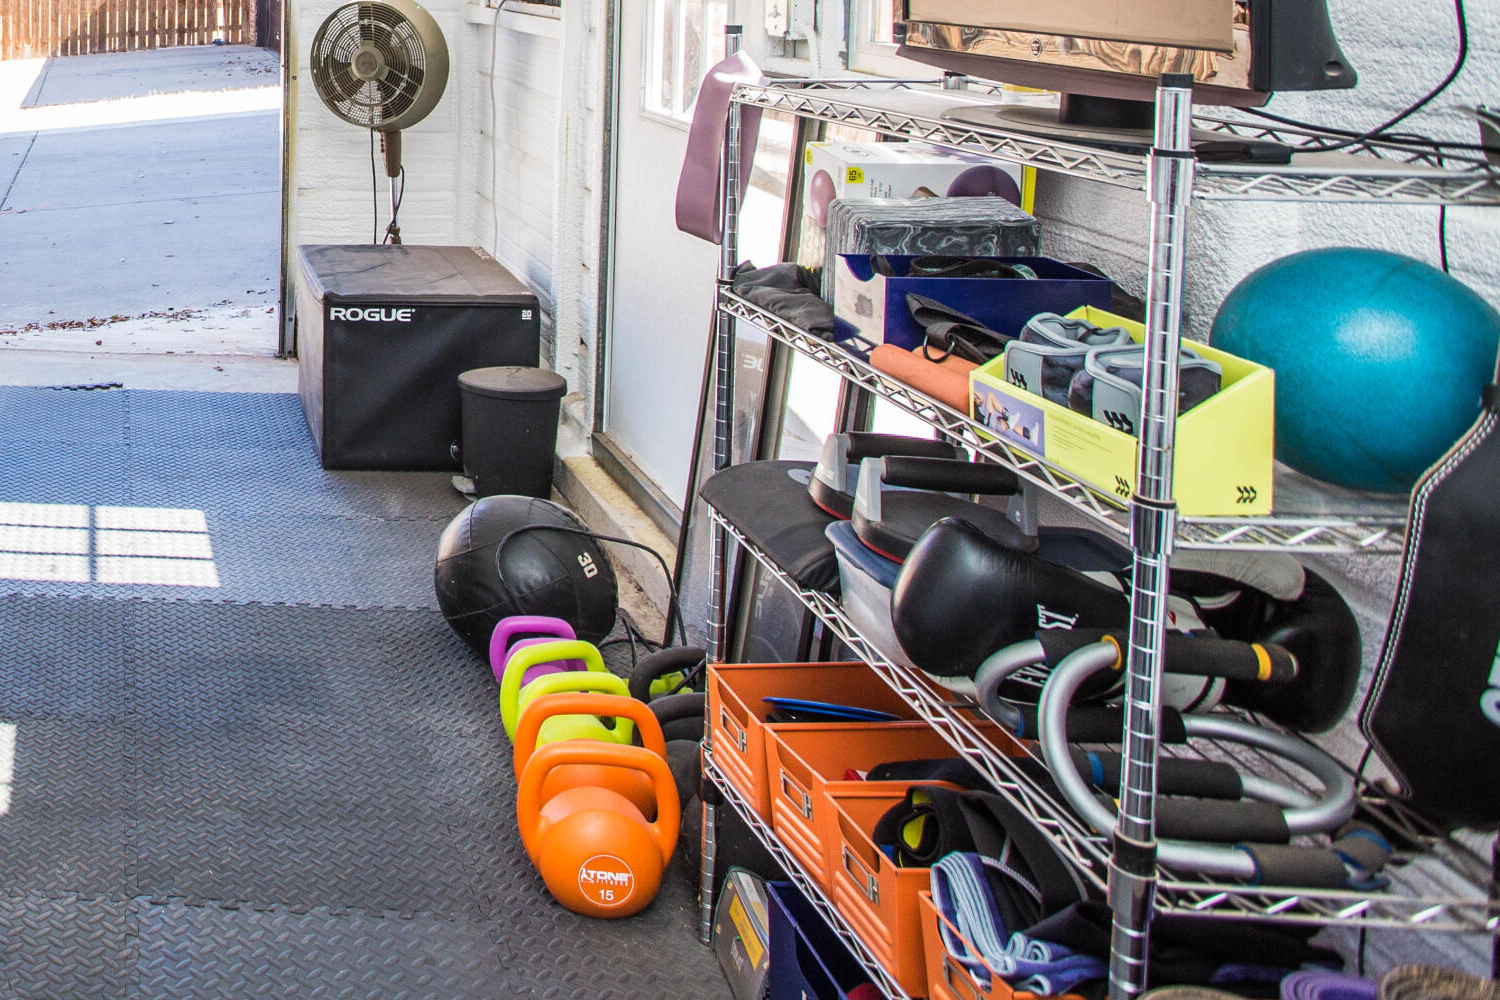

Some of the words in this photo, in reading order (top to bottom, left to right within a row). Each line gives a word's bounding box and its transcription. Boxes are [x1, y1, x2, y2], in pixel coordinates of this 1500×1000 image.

[848, 170, 857, 181] 65
[330, 307, 412, 322] ROGUE
[521, 309, 532, 318] 20
[577, 551, 598, 579] 30
[587, 869, 629, 882] TONE
[599, 889, 614, 901] 15
